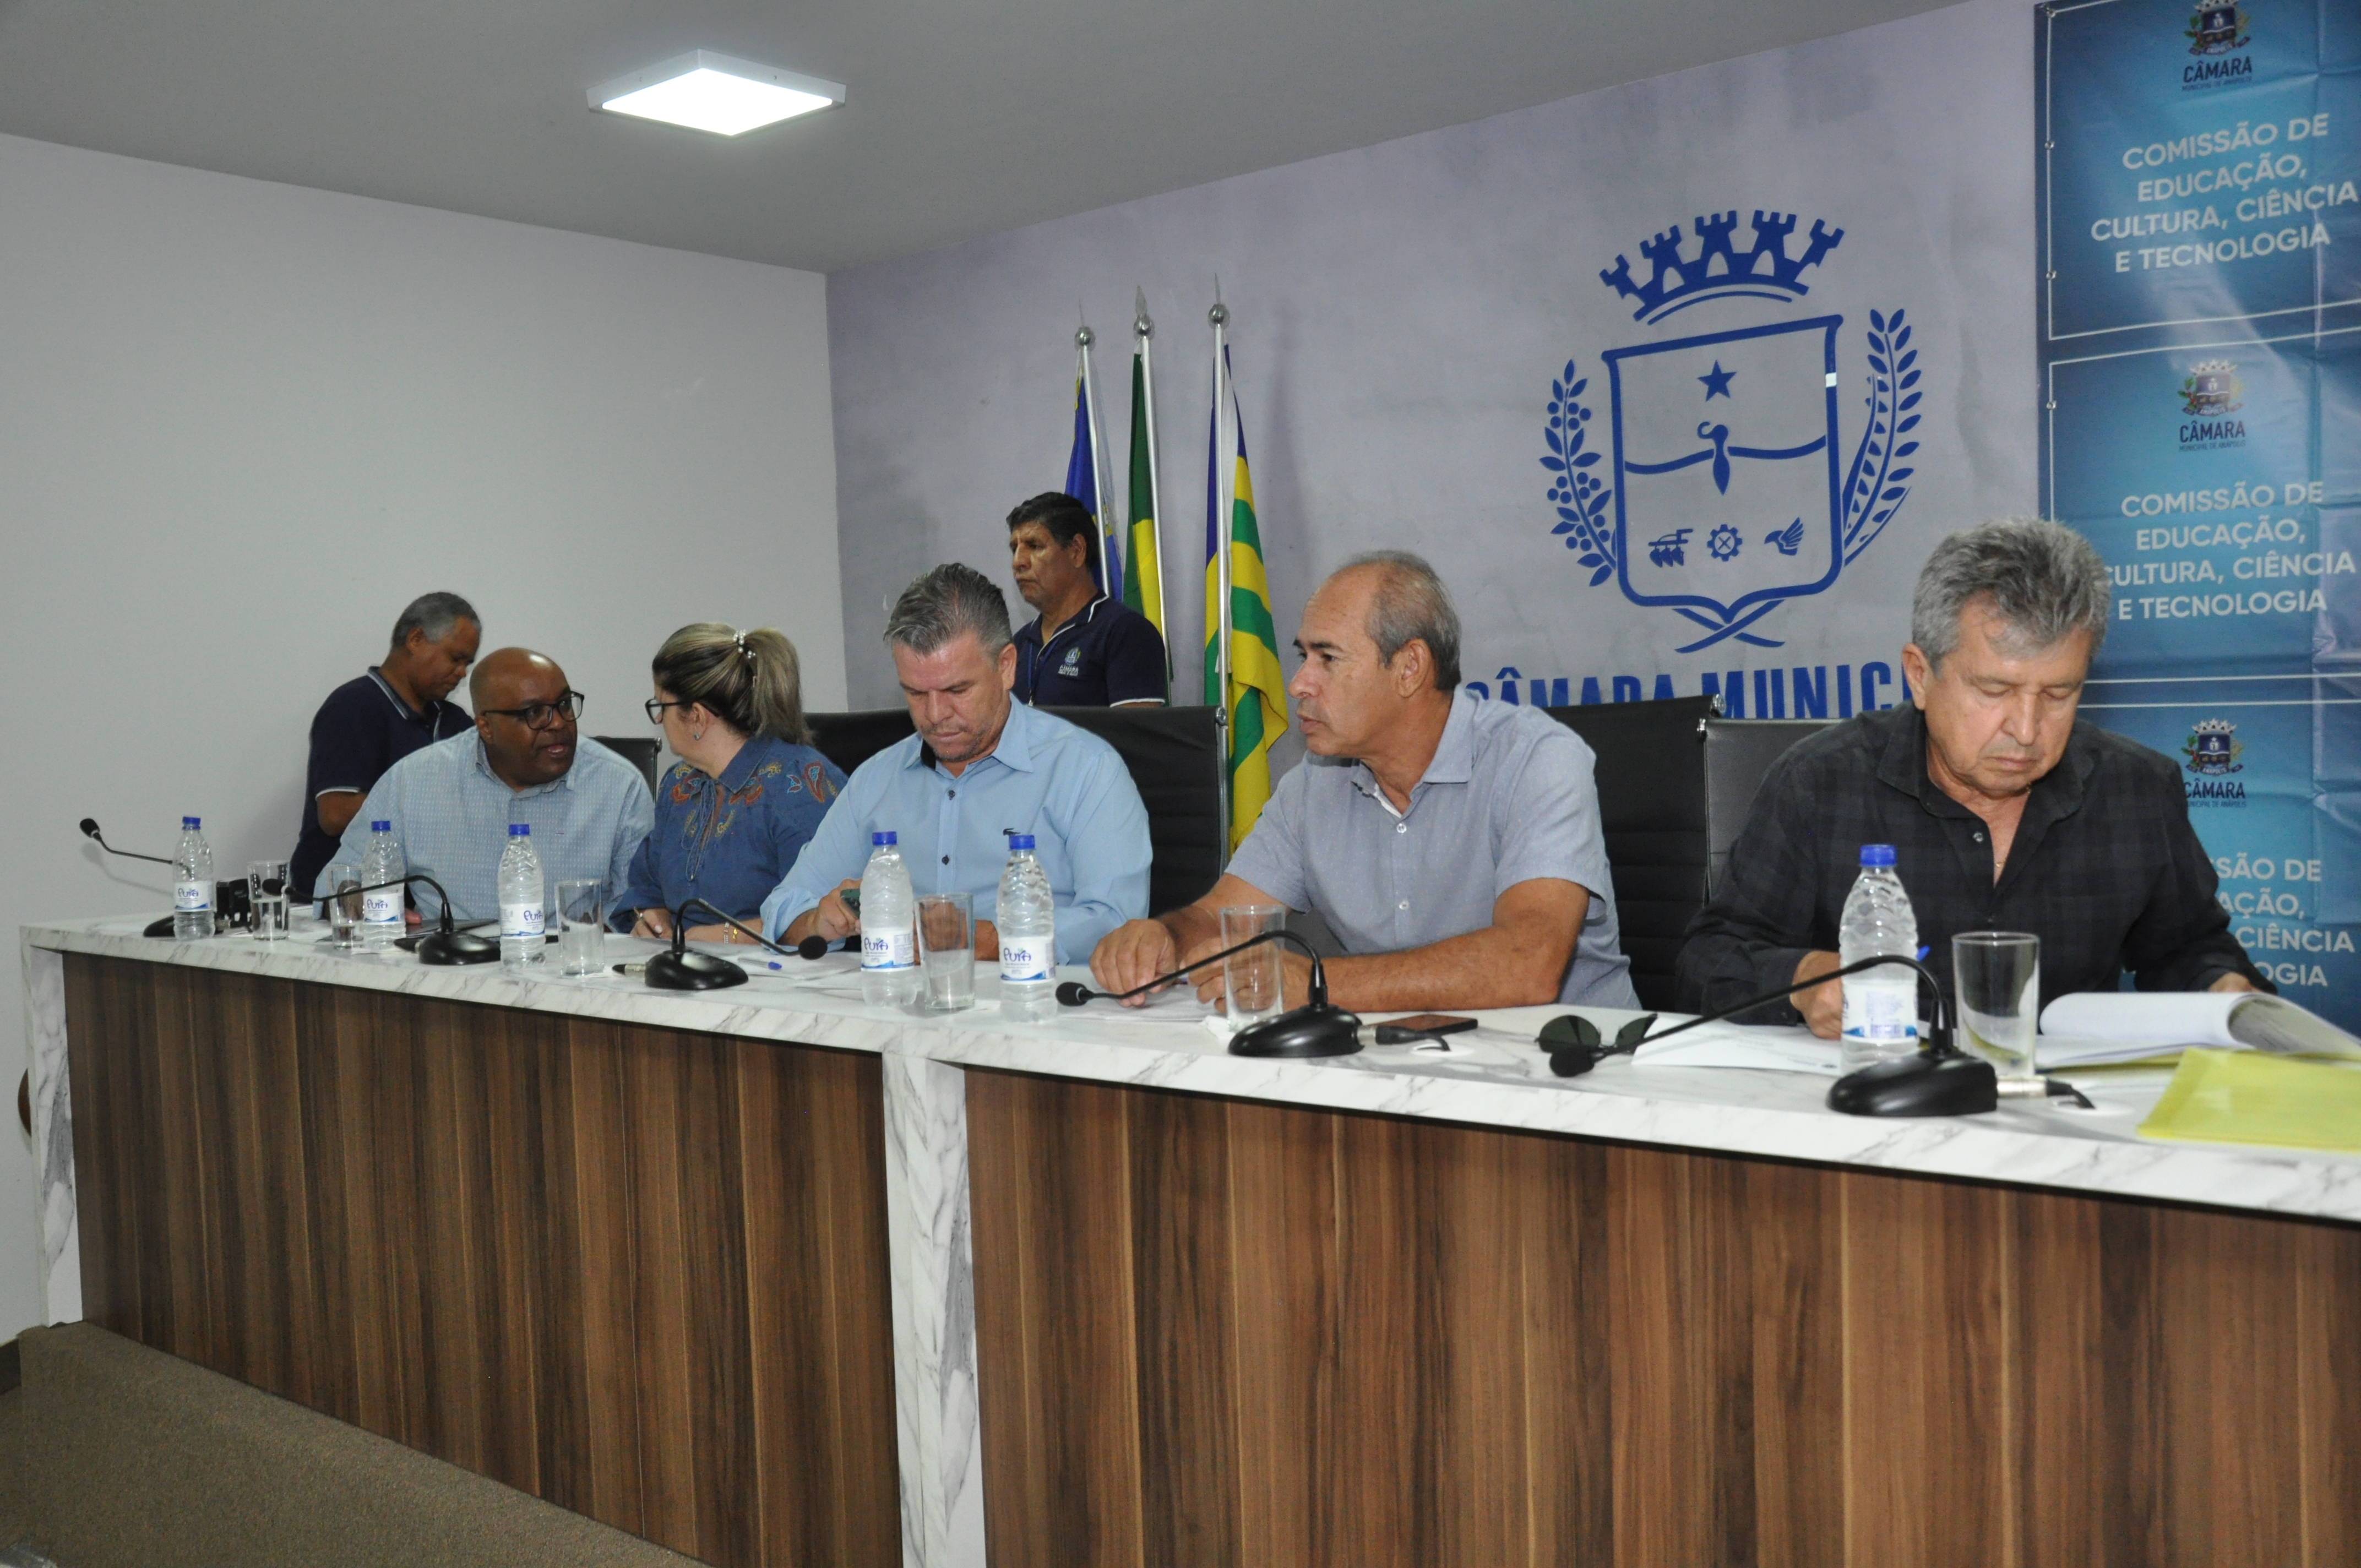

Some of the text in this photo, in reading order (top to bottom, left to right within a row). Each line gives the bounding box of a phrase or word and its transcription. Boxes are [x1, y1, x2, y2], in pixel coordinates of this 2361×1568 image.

[2183, 56, 2252, 83] CÂMARA
[2122, 113, 2330, 169] COMISSÃO DE
[2137, 153, 2307, 202] EDUCAÇÃO,
[2091, 181, 2359, 241] CULTURA, CIÊNCIA
[2115, 222, 2331, 273] E TECNOLOGIA
[2179, 420, 2245, 443] CÂMARA
[2121, 481, 2324, 518] COMISSÃO DE
[2136, 515, 2306, 550] EDUCAÇÃO,
[2233, 551, 2356, 580] CIÊNCIA
[2118, 589, 2328, 620] E TECNOLOGIA
[1701, 661, 1913, 718] MUNIC
[2284, 859, 2322, 882] DE
[2218, 887, 2305, 919] AÇÃO,
[2235, 922, 2355, 953] CIÊNCIA
[2255, 962, 2328, 987] OGIA
